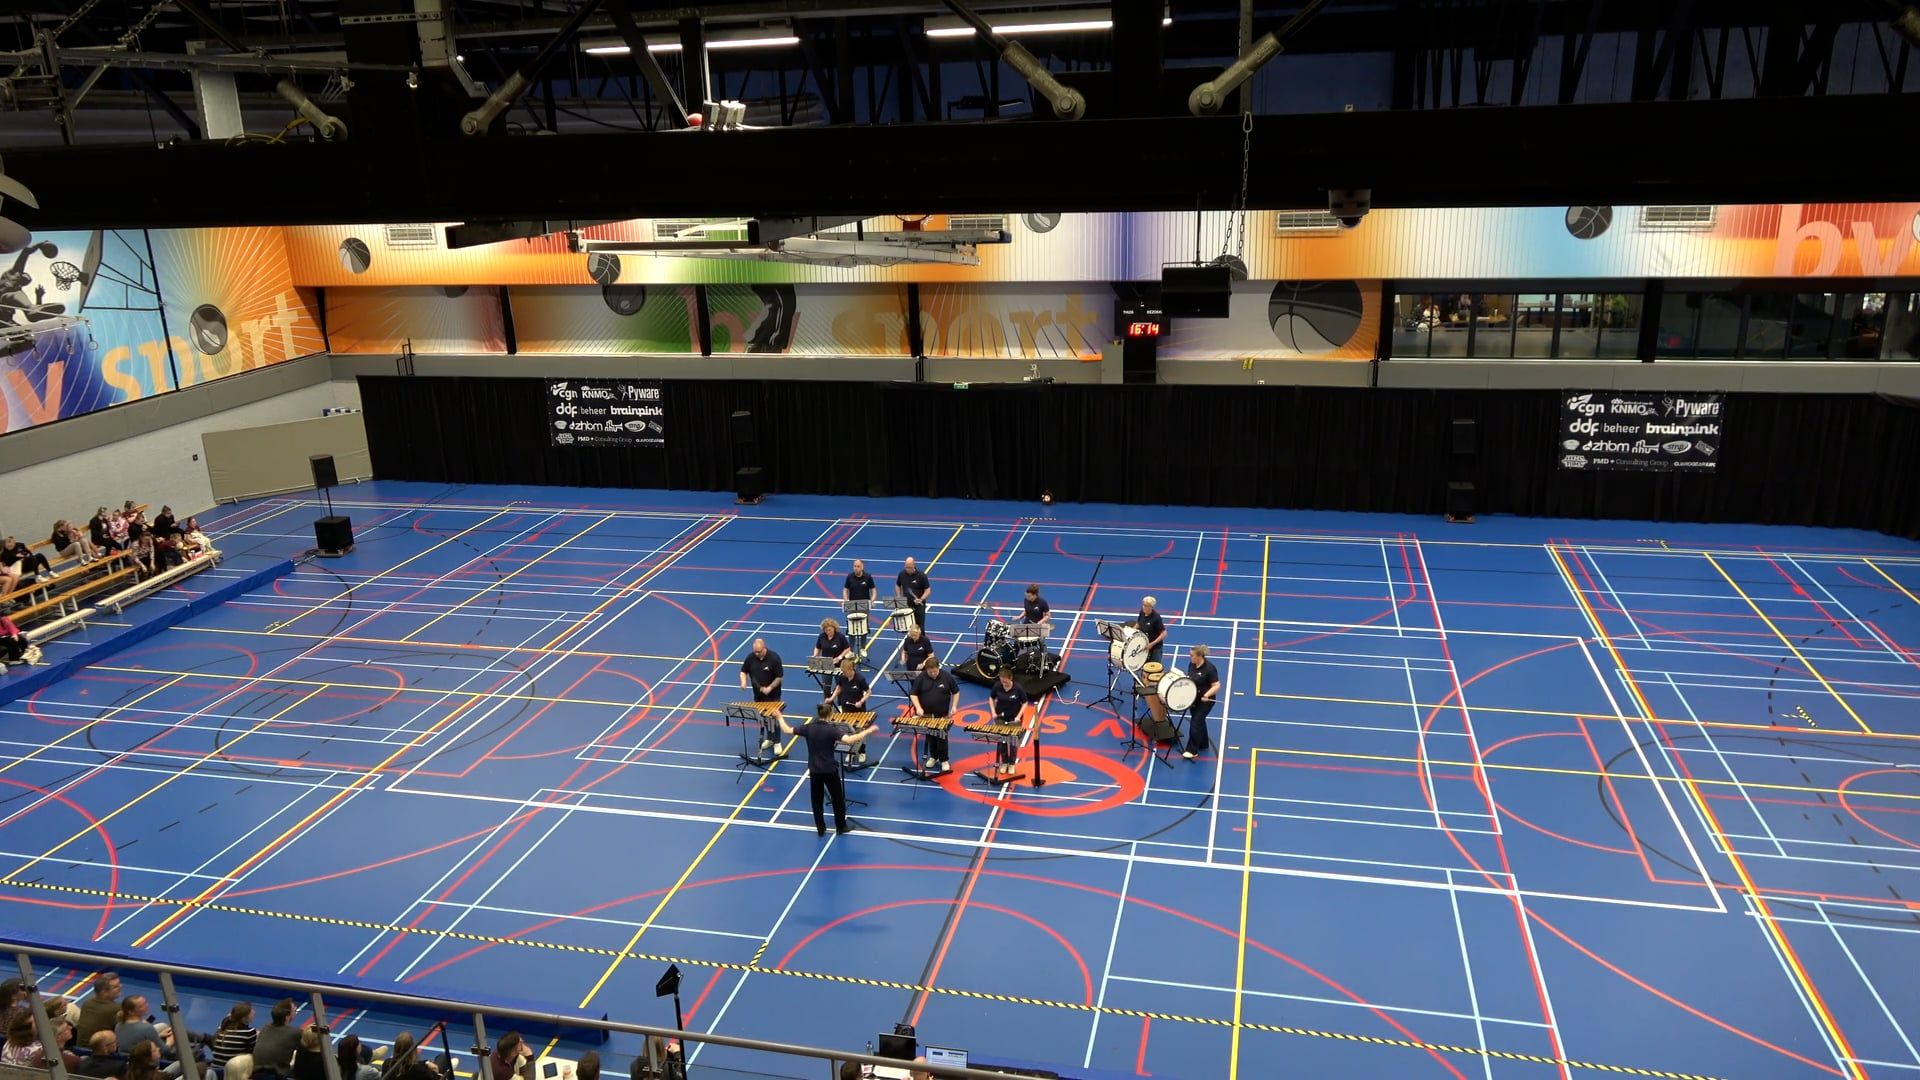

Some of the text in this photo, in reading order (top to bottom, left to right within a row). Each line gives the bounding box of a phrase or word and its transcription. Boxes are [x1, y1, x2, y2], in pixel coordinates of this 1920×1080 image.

[1130, 323, 1159, 335] 16:14
[559, 389, 578, 401] cgn
[582, 390, 608, 399] KNMO
[628, 385, 660, 401] Pyware
[556, 402, 607, 417] ddf beheer
[610, 406, 663, 417] brainpink
[1578, 403, 1604, 416] cgn
[1611, 404, 1646, 415] KNMO
[1675, 399, 1719, 417] Pyware
[575, 421, 603, 431] zhbm
[1569, 418, 1640, 436] ddf beheer
[1646, 422, 1719, 436] brainpink
[1592, 440, 1630, 452] zhbm
[1615, 458, 1649, 467] Consulting
[1649, 459, 1669, 467] Group
